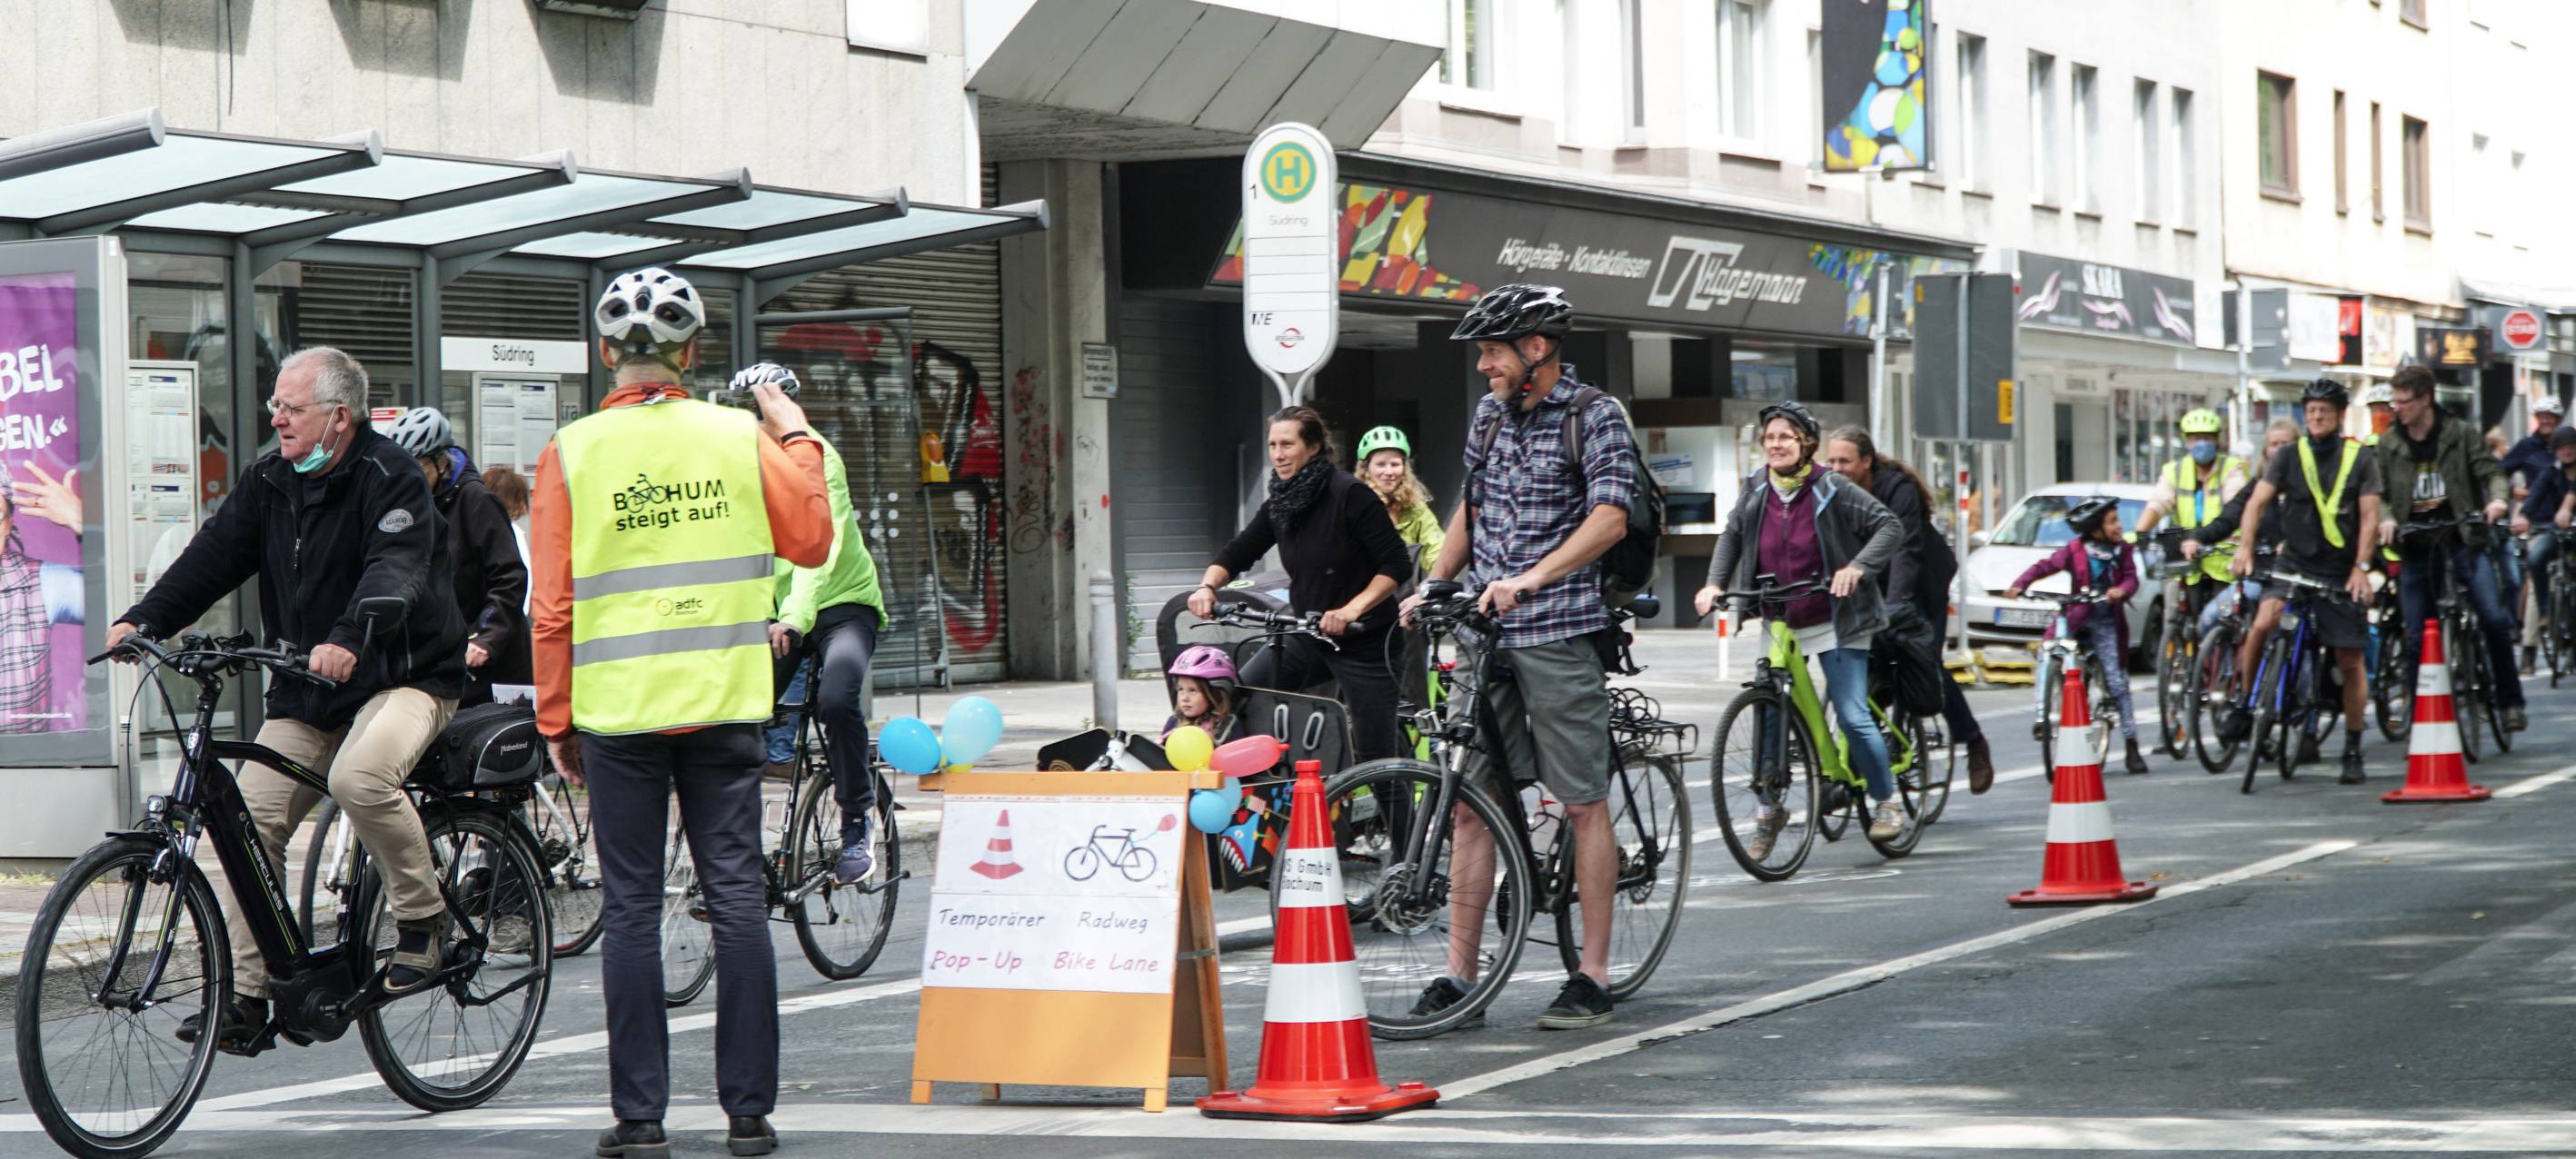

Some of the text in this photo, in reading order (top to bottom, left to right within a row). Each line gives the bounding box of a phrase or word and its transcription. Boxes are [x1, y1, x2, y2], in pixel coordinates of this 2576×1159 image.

[1276, 156, 1301, 188] H
[1250, 184, 1257, 200] 1
[492, 344, 535, 366] Südring
[616, 500, 730, 531] steigt auf!
[675, 598, 703, 609] adfc
[1298, 857, 1333, 877] GmbH
[939, 908, 1149, 935] Temporärer Radweg
[1053, 951, 1097, 971] Bike
[1109, 953, 1159, 972] Lane
